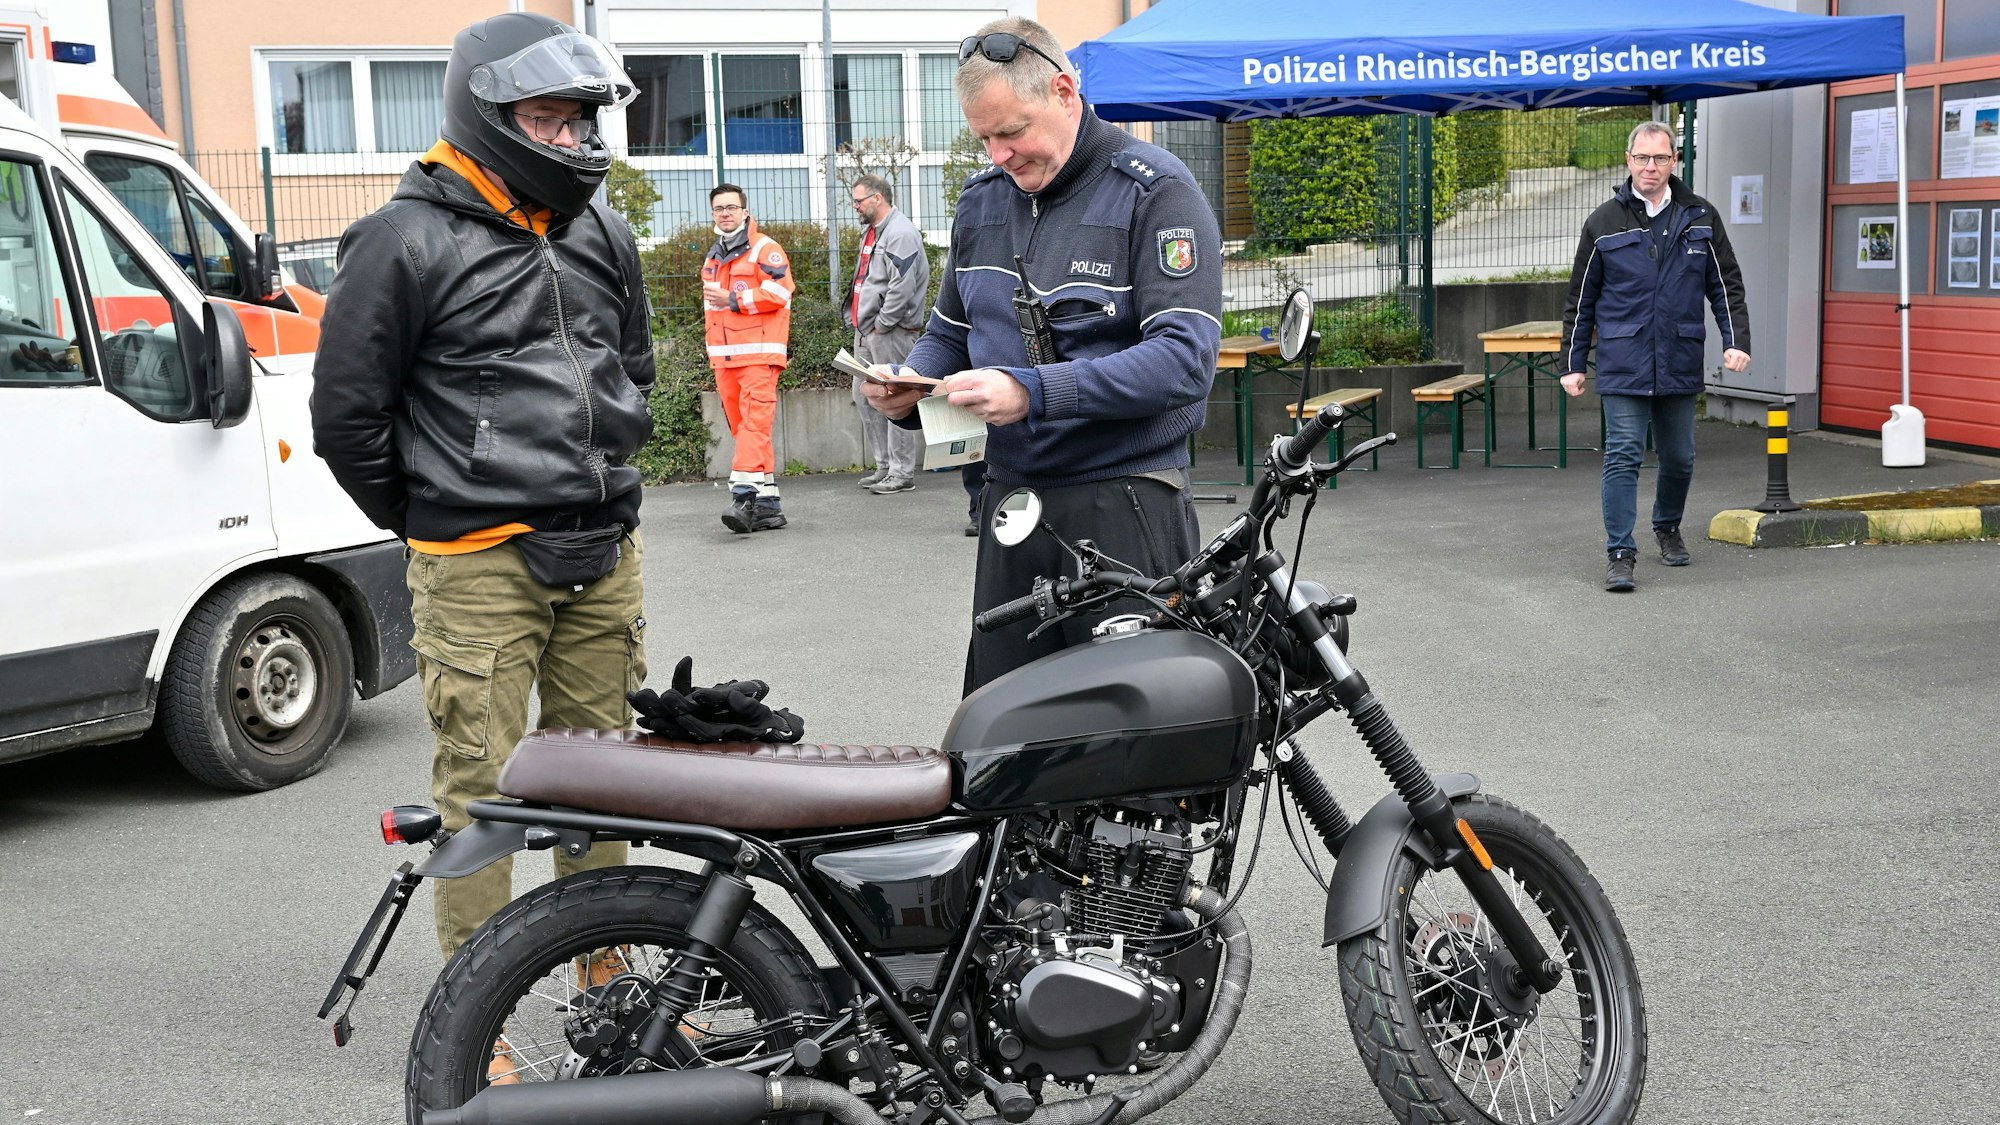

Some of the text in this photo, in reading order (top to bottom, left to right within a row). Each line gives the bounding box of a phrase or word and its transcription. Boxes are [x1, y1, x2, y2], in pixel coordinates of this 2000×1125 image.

[1243, 40, 1766, 84] Polizei Rheinisch-Bergischer Kreis
[1160, 230, 1193, 241] POLIZEI
[1070, 261, 1111, 276] POLIZEI
